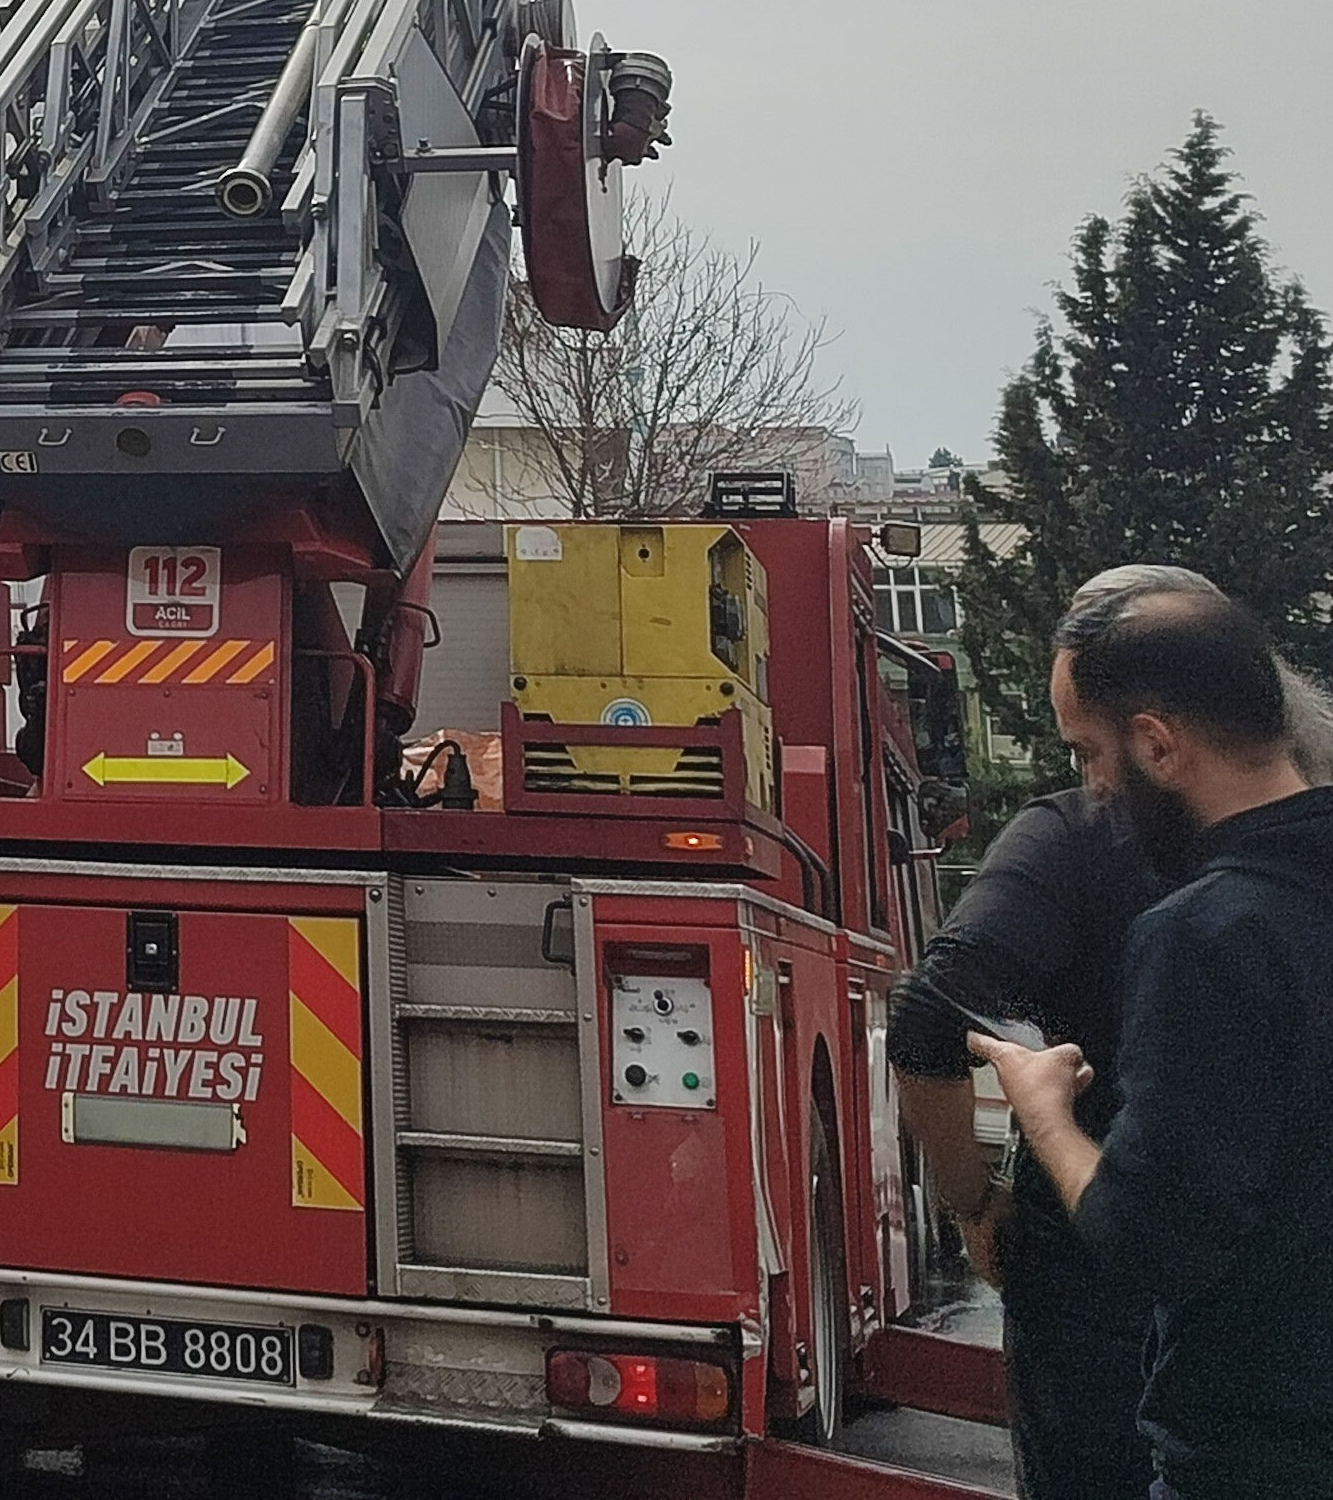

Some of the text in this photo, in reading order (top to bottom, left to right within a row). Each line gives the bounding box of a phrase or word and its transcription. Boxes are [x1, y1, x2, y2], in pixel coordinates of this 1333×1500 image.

[144, 555, 206, 596] 112
[50, 1317, 283, 1376] 34 BB 8808
